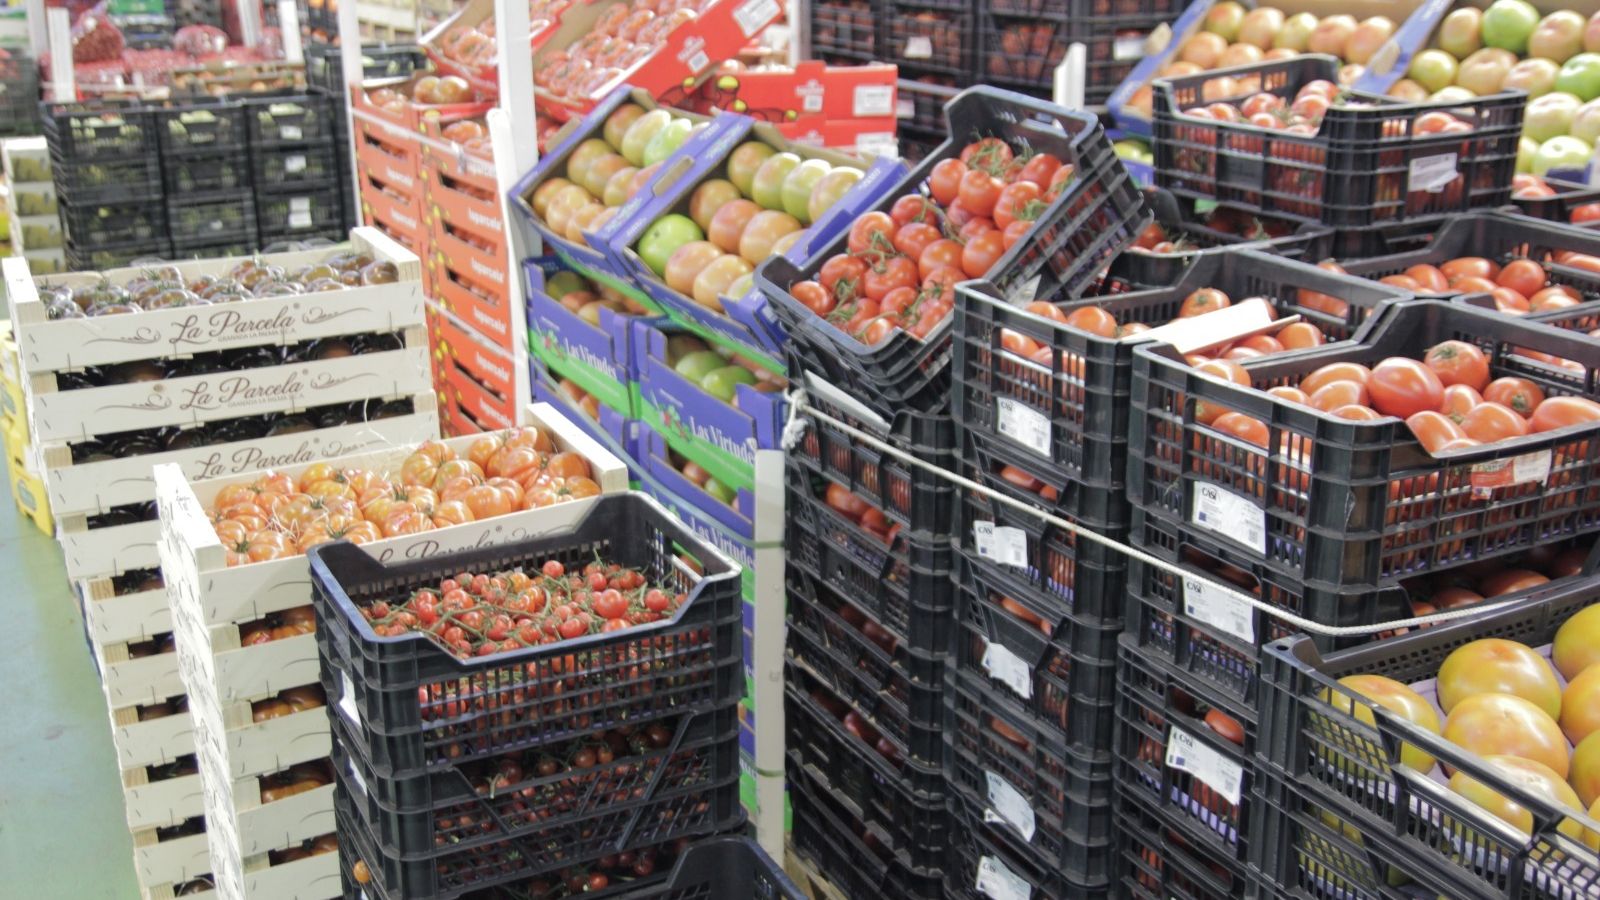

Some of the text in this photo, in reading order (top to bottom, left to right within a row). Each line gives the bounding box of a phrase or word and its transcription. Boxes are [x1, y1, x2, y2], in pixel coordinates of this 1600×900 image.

[169, 305, 295, 345] La Parcela
[578, 344, 618, 380] Virtudes
[179, 371, 304, 410] La Parcela
[689, 415, 710, 441] Las
[193, 440, 316, 480] La Parcela
